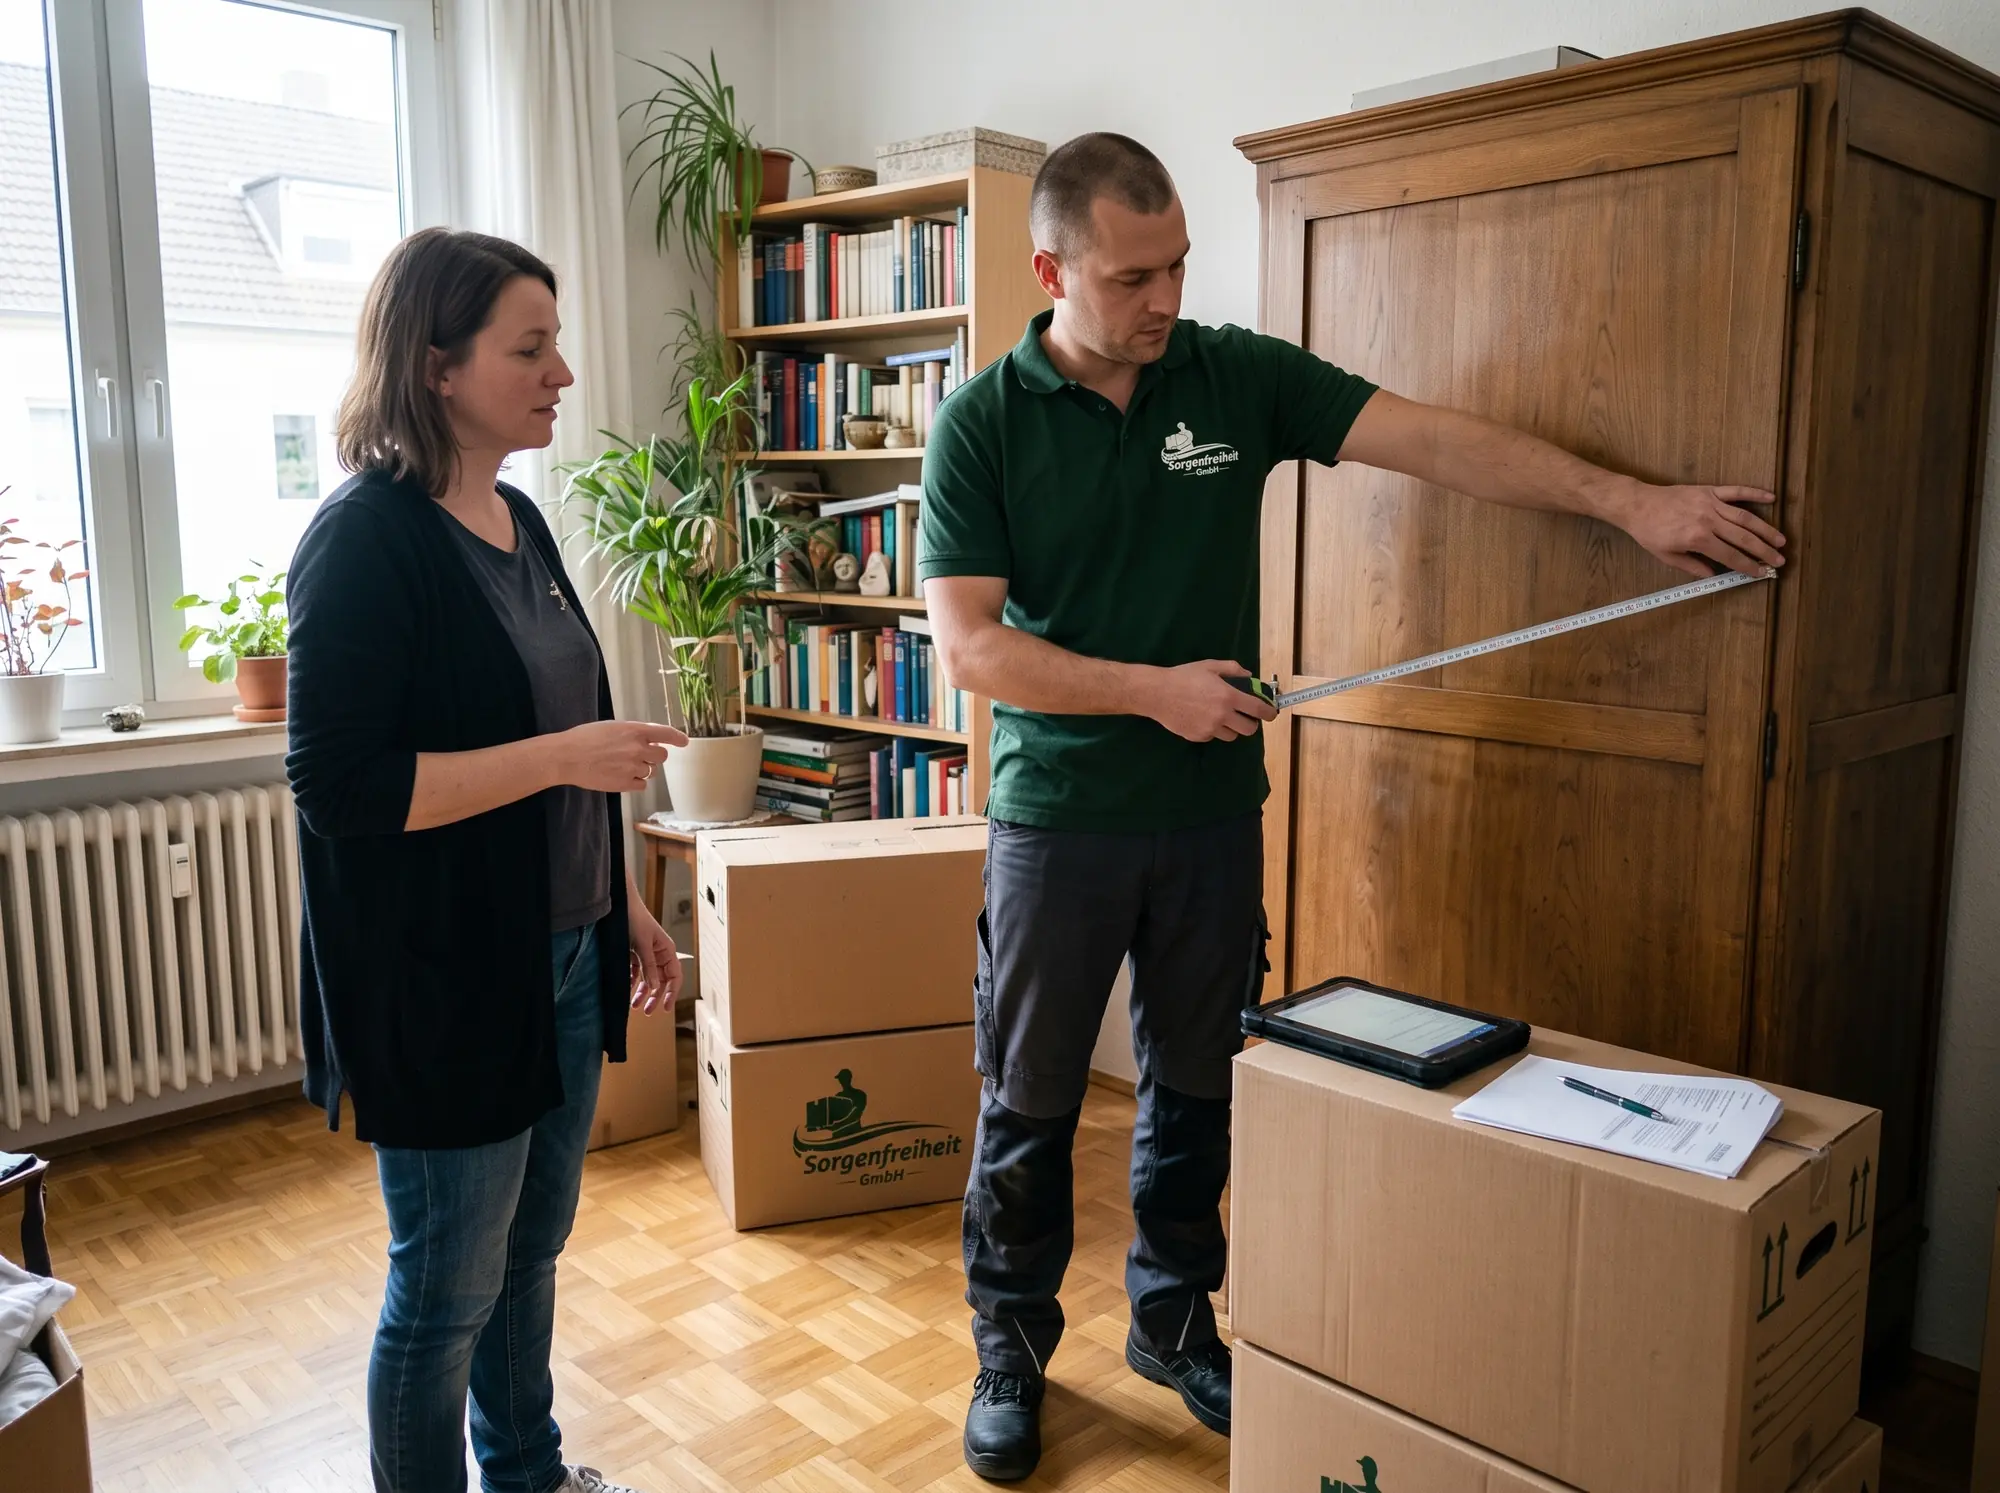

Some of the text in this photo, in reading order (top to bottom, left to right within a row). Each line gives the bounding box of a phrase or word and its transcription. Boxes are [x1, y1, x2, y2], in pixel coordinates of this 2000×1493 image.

[1168, 450, 1239, 471] Sorgenfreiheit
[1195, 466, 1219, 476] GmbH
[803, 1135, 962, 1175] Sorgenfreiheit
[859, 1169, 905, 1186] GmbH
